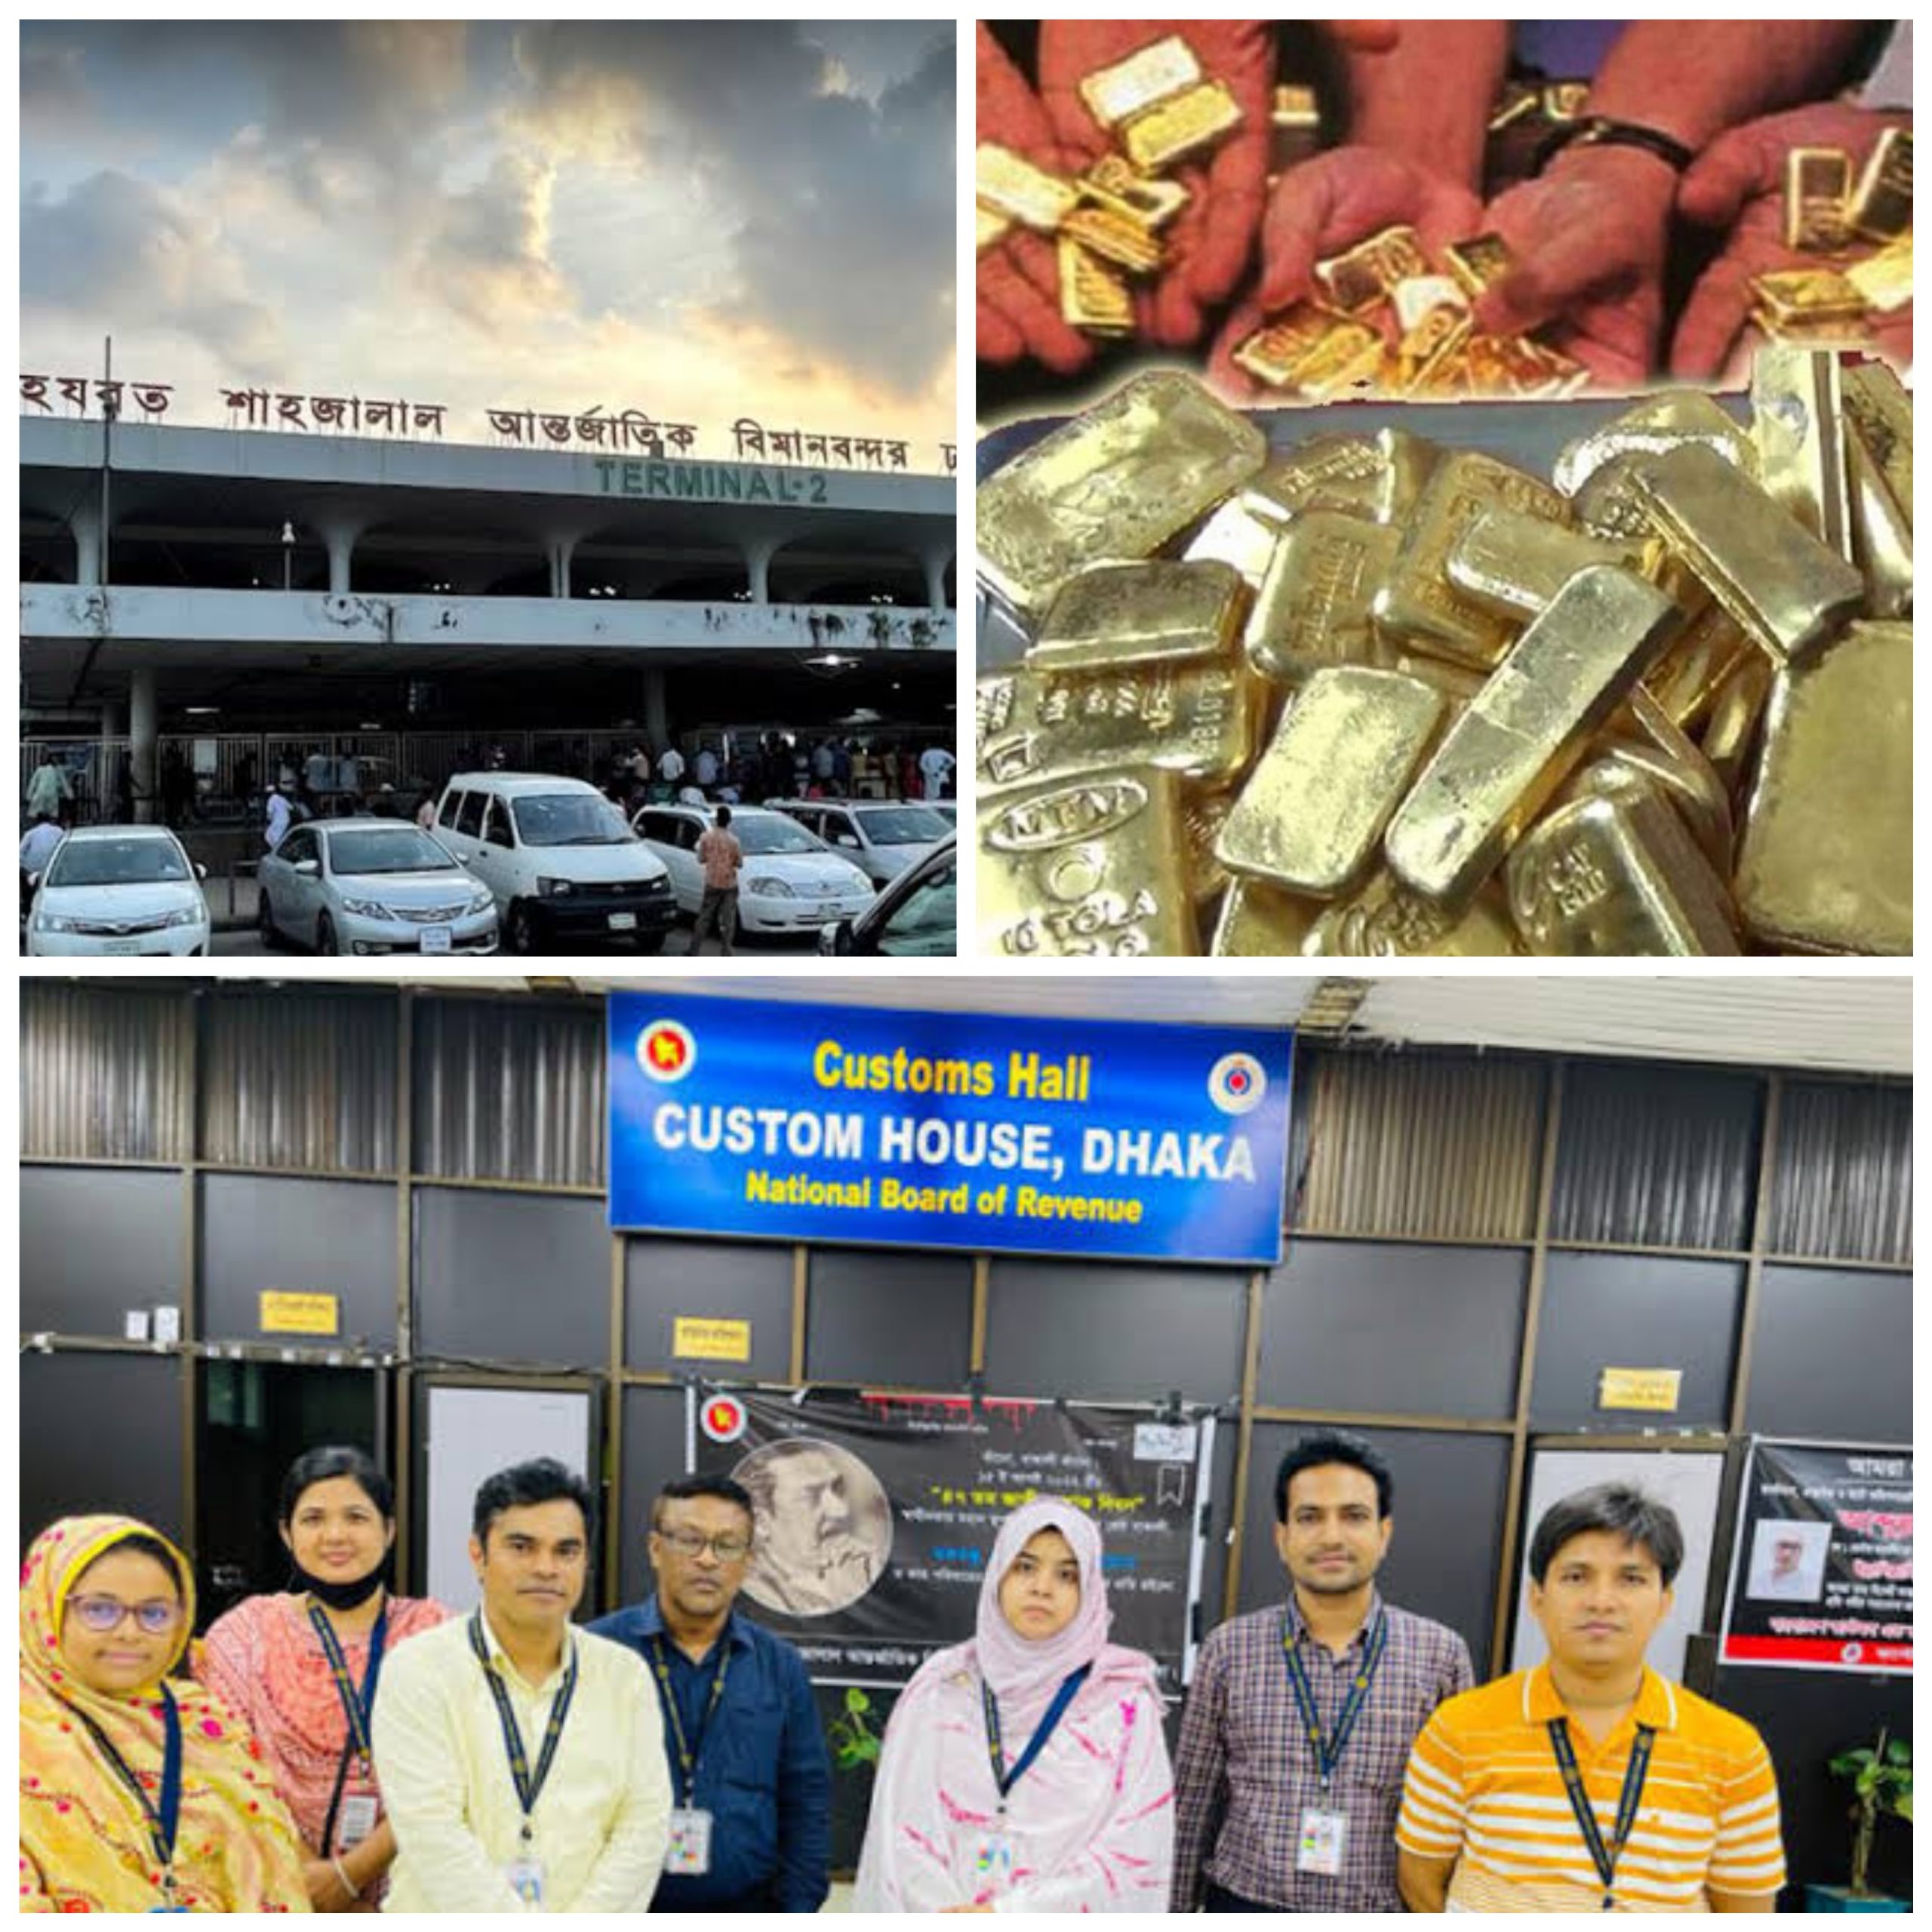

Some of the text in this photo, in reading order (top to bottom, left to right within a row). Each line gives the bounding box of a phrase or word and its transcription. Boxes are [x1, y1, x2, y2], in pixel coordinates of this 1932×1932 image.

[220, 386, 448, 435] শাহজালাল
[485, 405, 697, 453] আন্তর্জাতিক
[732, 418, 910, 469] বিমানবন্দর
[813, 1039, 1091, 1102] Customs Hall
[654, 1103, 1256, 1183] CUSTOM HOUSE, DHAKA
[744, 1171, 1143, 1223] National Board of Revenue
